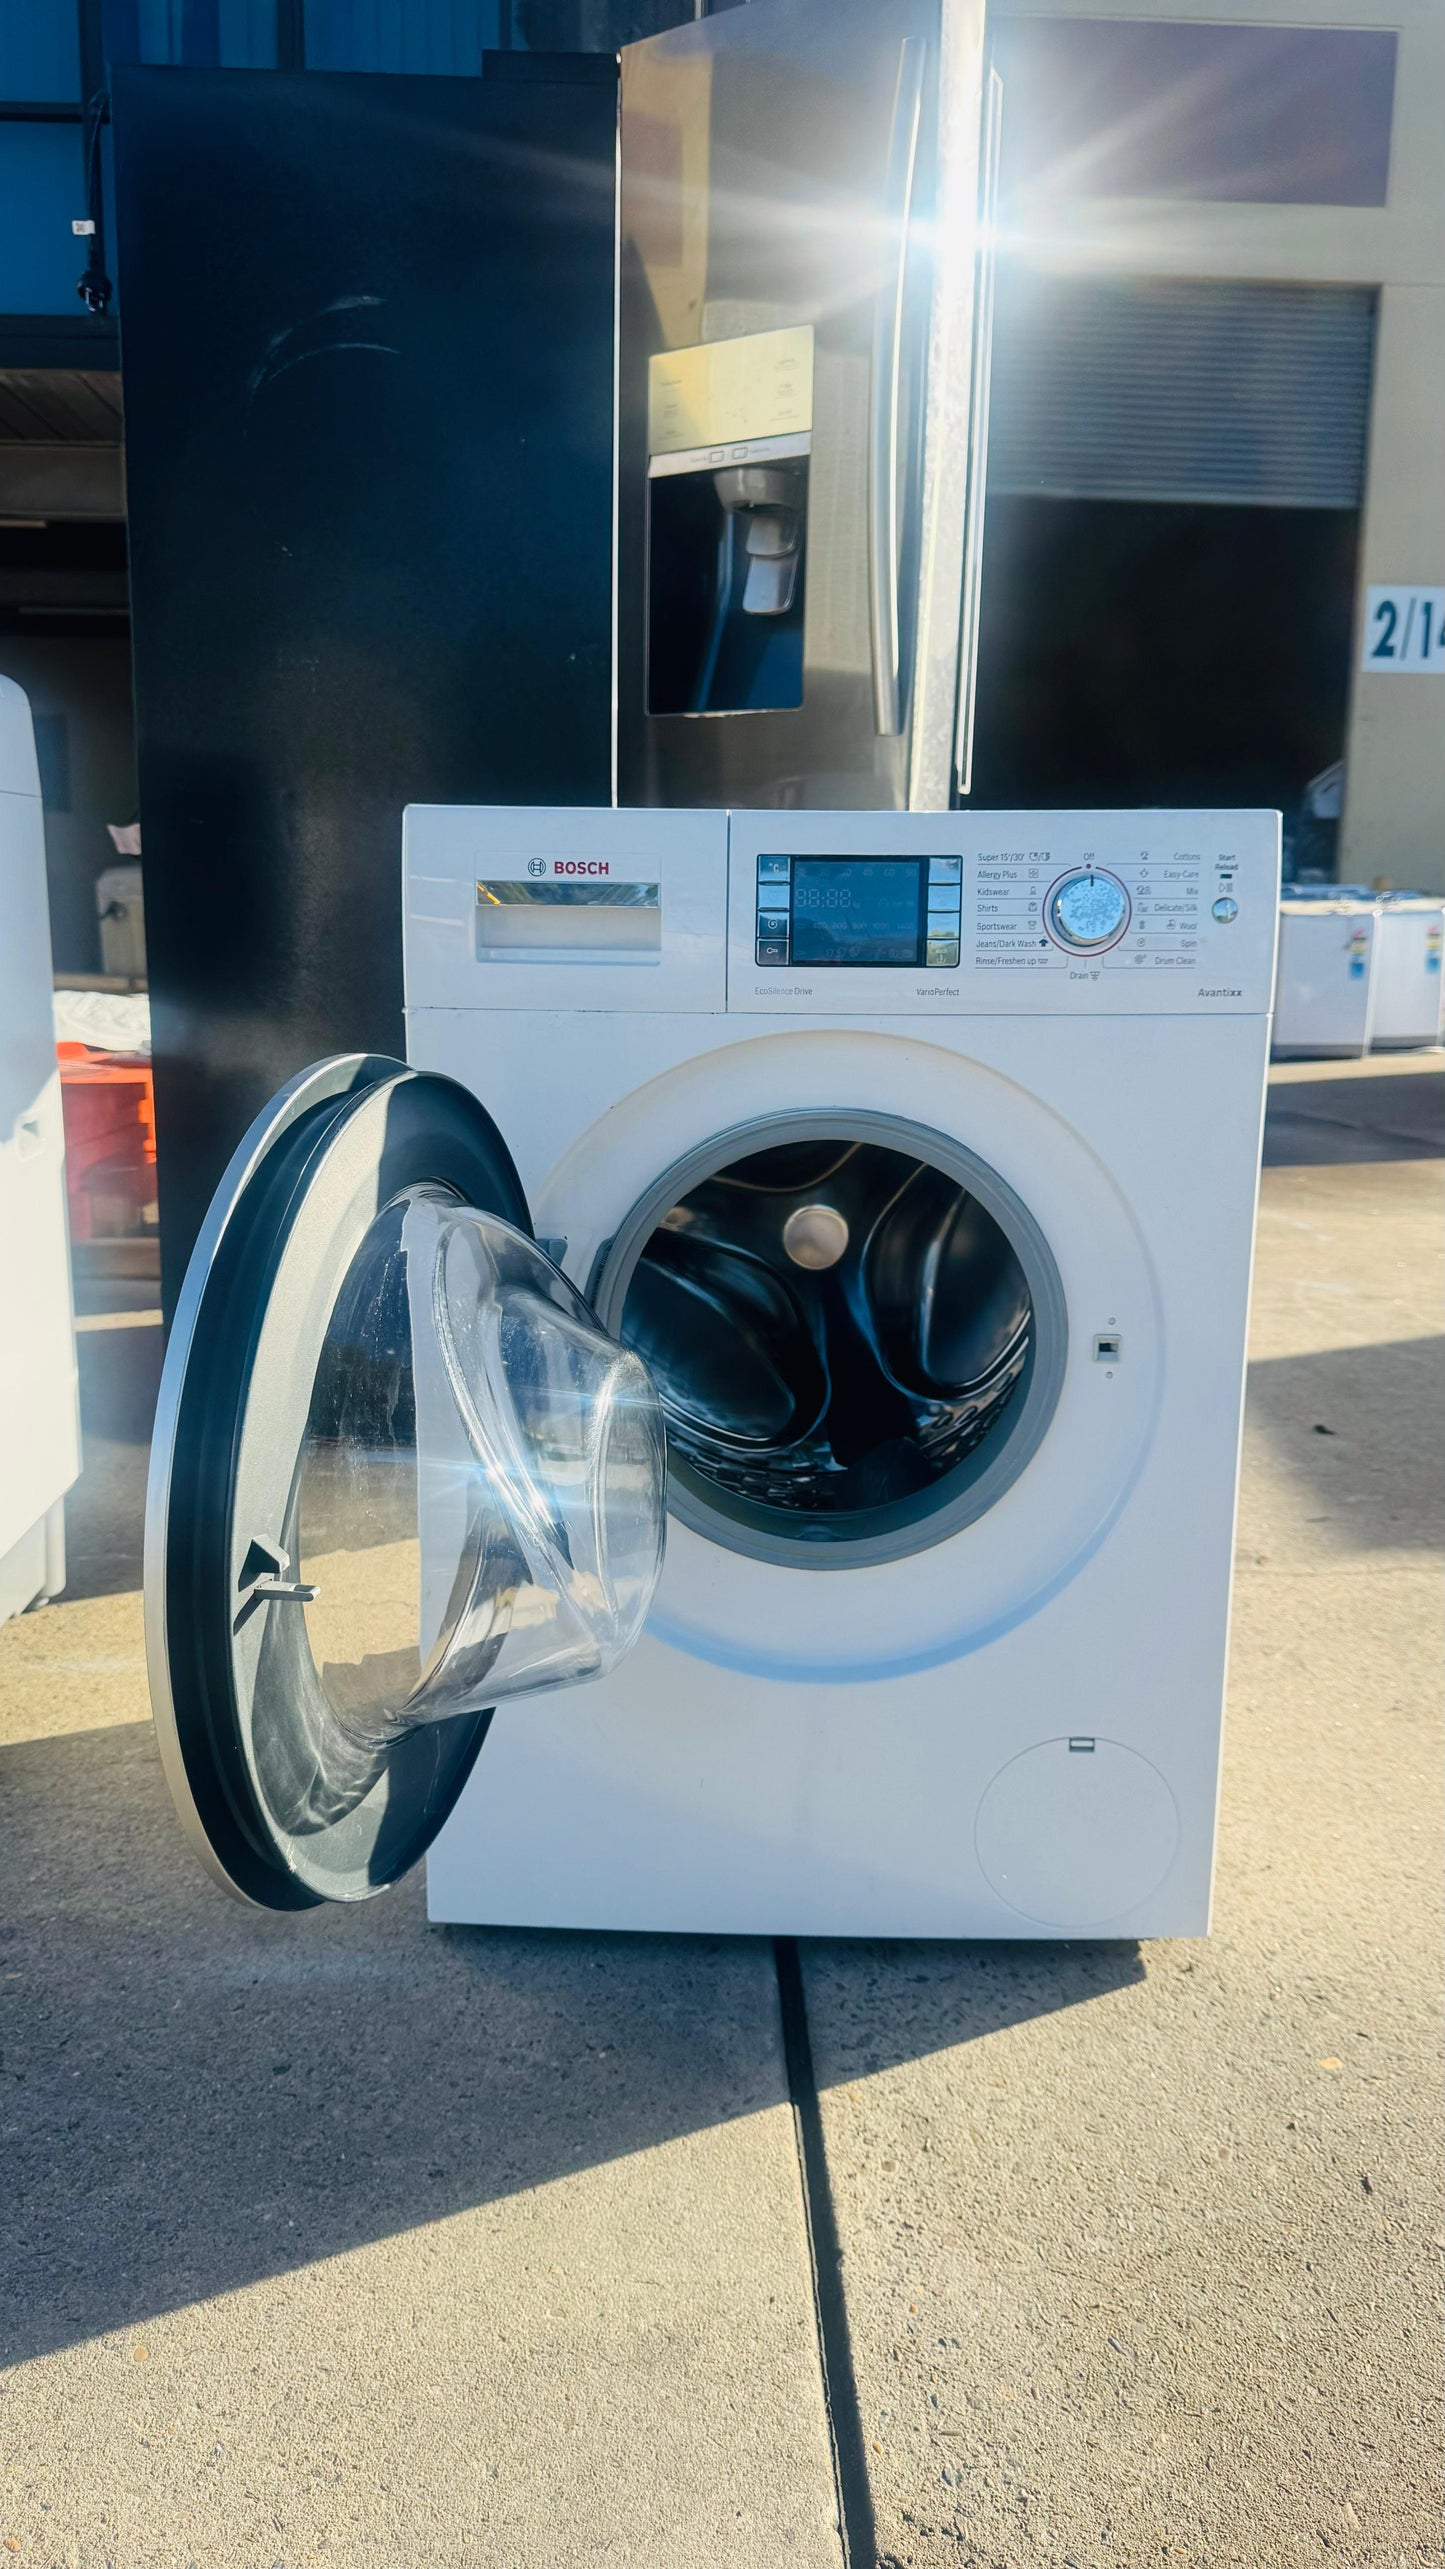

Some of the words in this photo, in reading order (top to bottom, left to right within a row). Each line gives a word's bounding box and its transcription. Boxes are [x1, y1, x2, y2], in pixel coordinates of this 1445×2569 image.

[977, 853, 999, 862] Super
[1083, 852, 1095, 860] Off
[1173, 852, 1201, 860] Cottons
[554, 861, 609, 875] BOSCH
[1214, 863, 1239, 871] Reload
[977, 870, 1001, 880] Allergy
[1002, 870, 1018, 879] Plus
[977, 888, 1010, 896] Kidswear
[1186, 887, 1198, 895] Mix
[977, 904, 999, 912] Shirts
[1154, 903, 1197, 912] Delicate/Silk
[976, 922, 1017, 931] Sportswear
[1180, 922, 1197, 930] Wool
[976, 939, 1016, 948] Jeans/Dark
[1017, 940, 1037, 948] Wash
[1181, 939, 1197, 948] Spin
[975, 956, 1026, 966] Rinse/Freshen
[1026, 958, 1037, 966] up
[1155, 956, 1175, 965] Drum
[1175, 956, 1196, 965] Clean
[1070, 971, 1089, 980] Drain
[754, 987, 794, 995] EcoSilence
[794, 987, 813, 995] Drive
[916, 987, 960, 996] VarioPerfect
[1197, 988, 1243, 997] Avantixx
